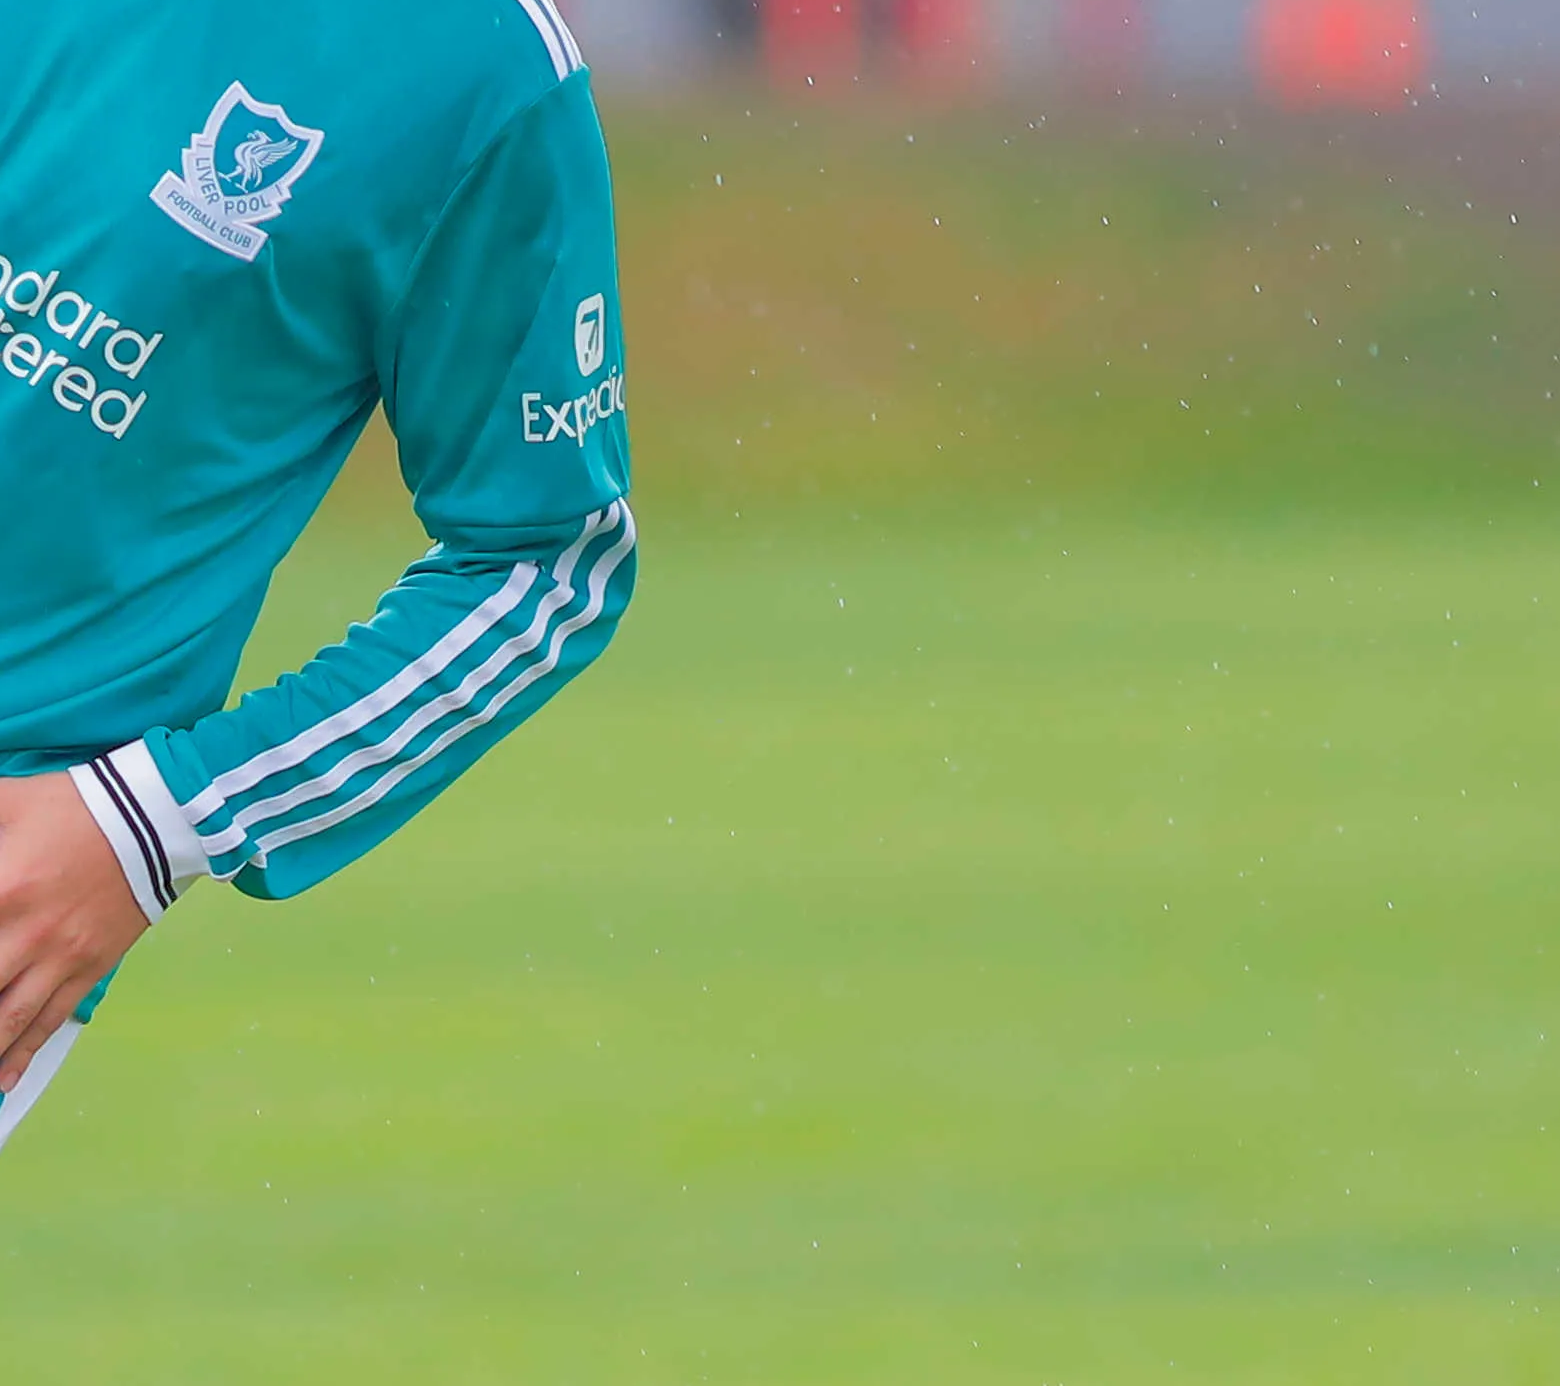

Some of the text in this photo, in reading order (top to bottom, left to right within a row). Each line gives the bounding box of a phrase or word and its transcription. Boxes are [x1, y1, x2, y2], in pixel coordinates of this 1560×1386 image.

[194, 156, 272, 215] LIVER POOL
[166, 189, 252, 249] FOOTBALL CLUB
